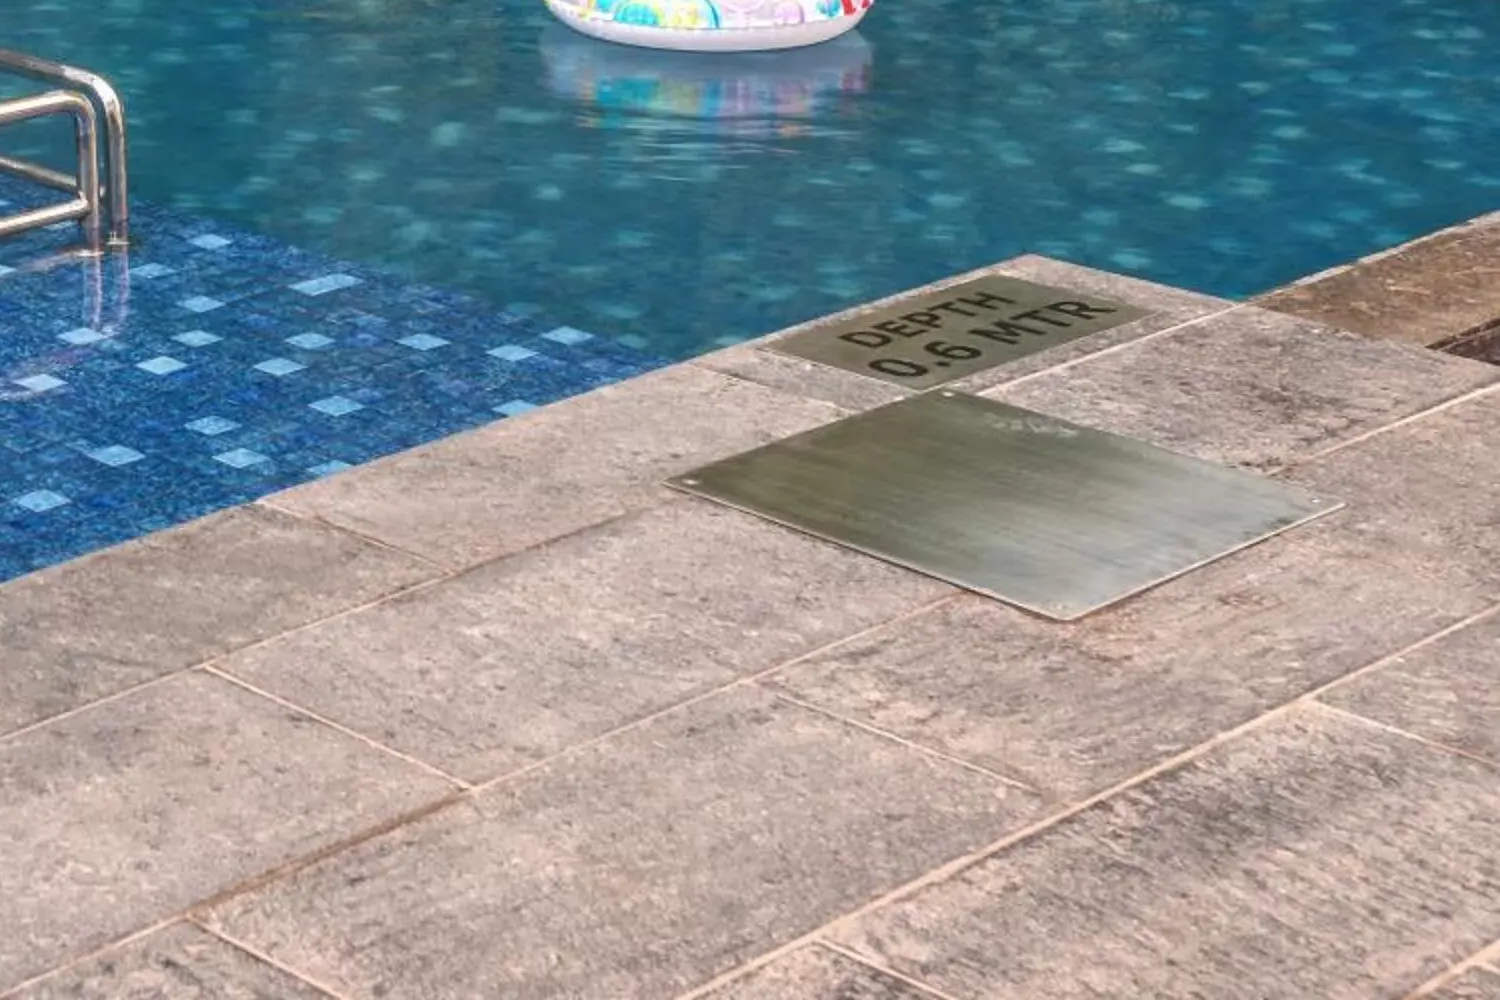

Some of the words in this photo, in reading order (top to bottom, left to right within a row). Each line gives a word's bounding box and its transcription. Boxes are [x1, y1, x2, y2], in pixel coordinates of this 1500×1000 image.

[838, 291, 1018, 349] DEPTH
[868, 340, 982, 378] 0.6
[968, 300, 1118, 346] MTR
